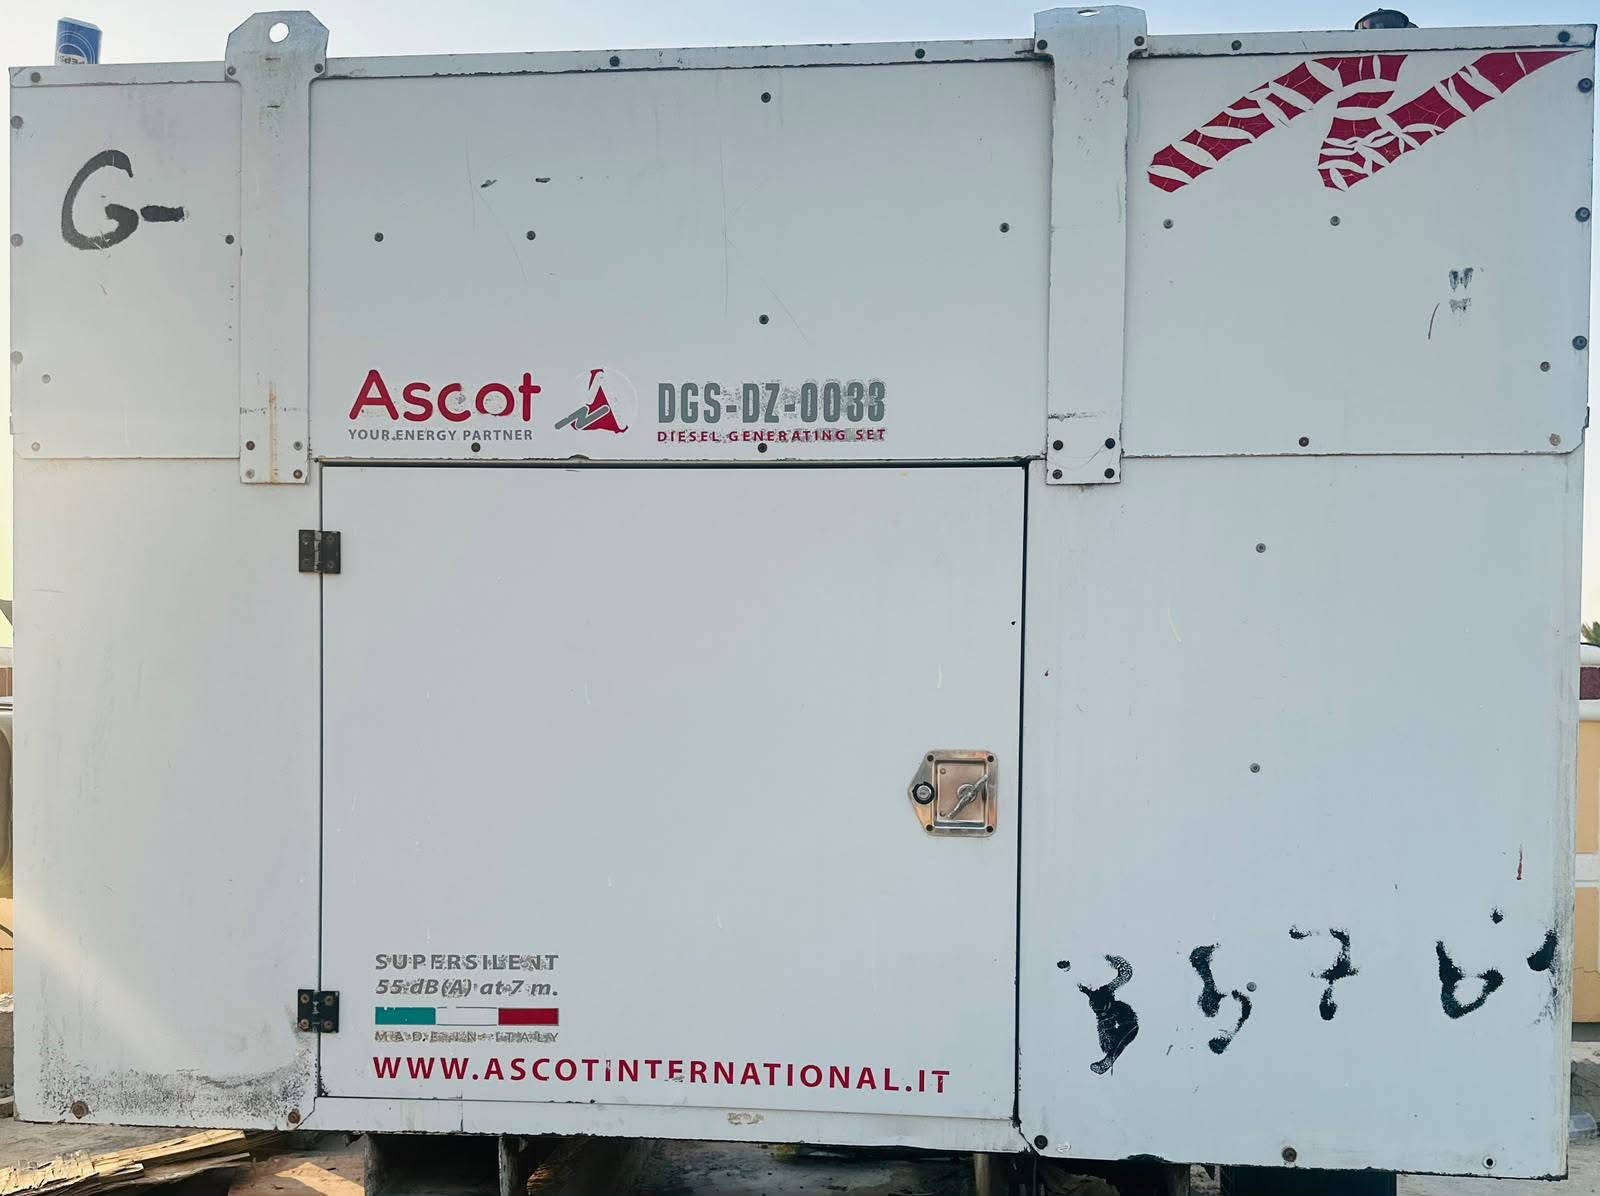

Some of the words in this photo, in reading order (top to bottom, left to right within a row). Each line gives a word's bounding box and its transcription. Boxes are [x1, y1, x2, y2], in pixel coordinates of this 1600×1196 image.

[349, 369, 542, 422] Ascot
[657, 381, 886, 424] DGS-DZ-0033
[348, 429, 390, 441] YOUR
[396, 430, 456, 441] ENERGY
[463, 430, 533, 441] PARTNER
[657, 430, 720, 442] DIESEL
[728, 429, 846, 442] GENERATING
[855, 428, 887, 440] SET
[375, 953, 560, 970] SUPERSILENT
[375, 979, 403, 995] 55
[409, 977, 472, 998] dB(A)
[479, 979, 505, 995] at
[510, 979, 525, 995] 7
[530, 982, 559, 996] m.
[372, 1056, 951, 1094] WWW.ASCOTINTERNATIONAL.IT
